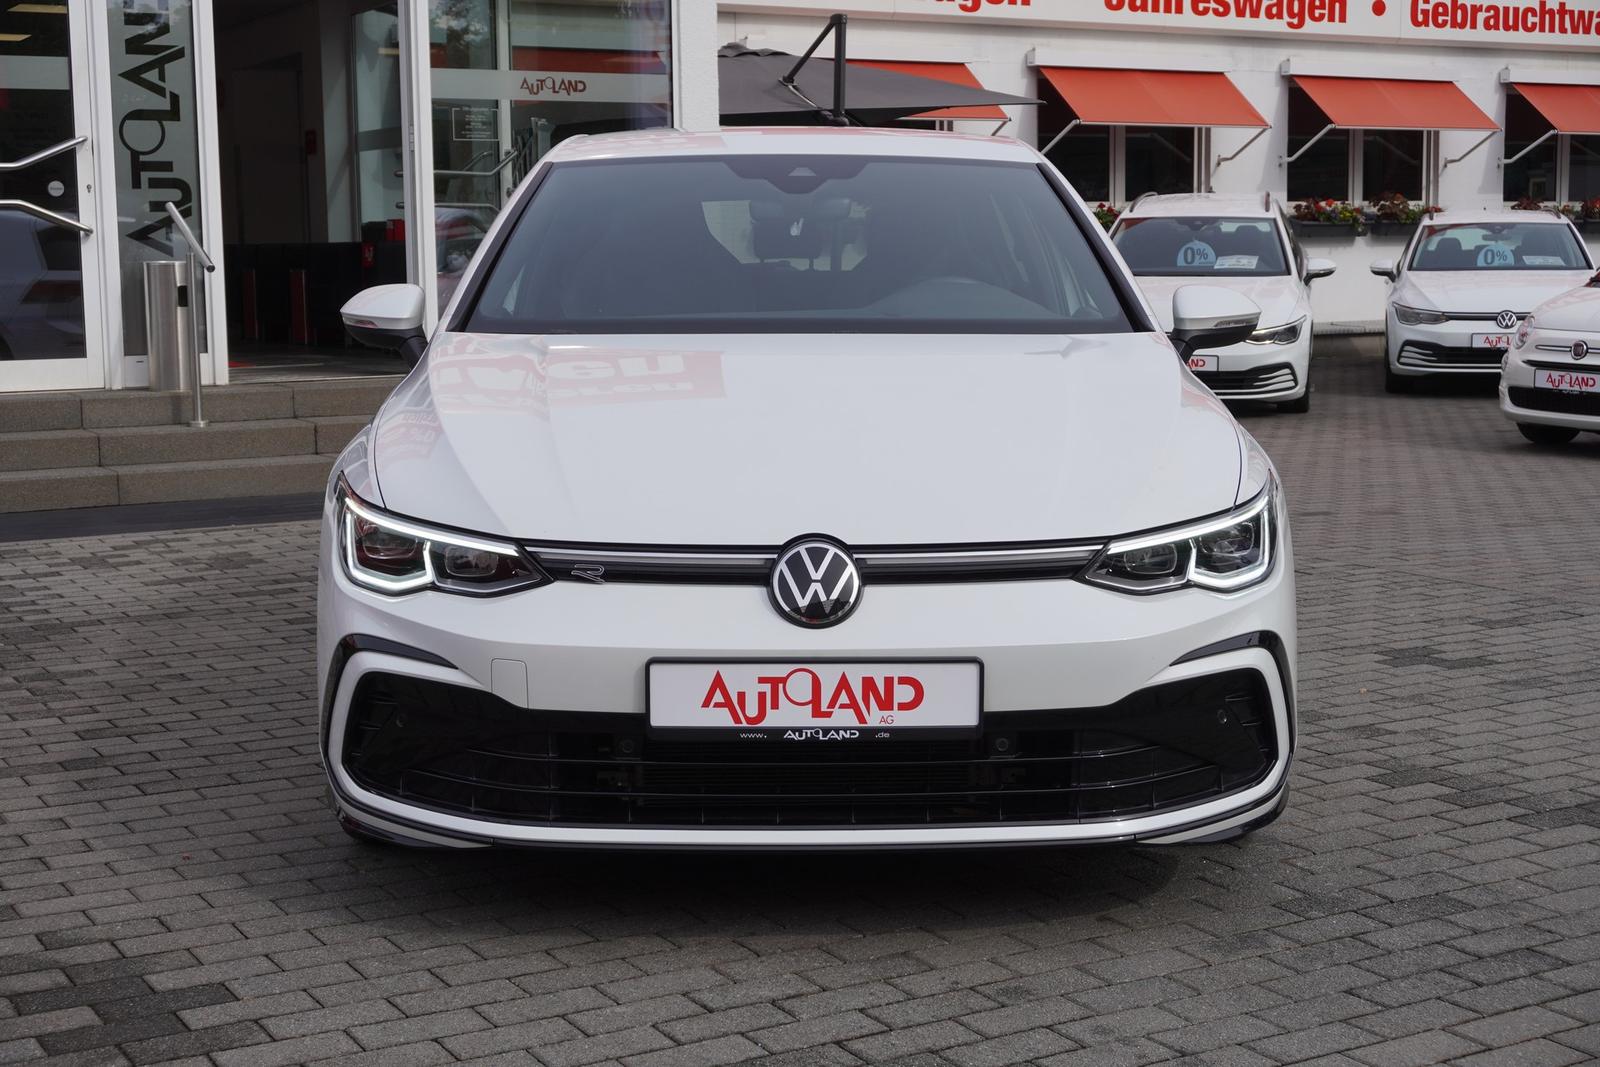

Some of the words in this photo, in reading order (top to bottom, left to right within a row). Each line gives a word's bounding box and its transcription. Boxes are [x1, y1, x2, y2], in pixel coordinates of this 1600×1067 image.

[520, 76, 587, 96] AUTOLAND
[118, 0, 192, 257] AUTOLAN
[1183, 246, 1209, 265] 0%
[1483, 248, 1508, 265] 0%
[1546, 372, 1596, 390] AUTOLAND
[776, 546, 855, 618] VW
[700, 667, 925, 725] AUTOLAND
[879, 715, 895, 725] AG
[783, 728, 860, 740] AUTOLAND
